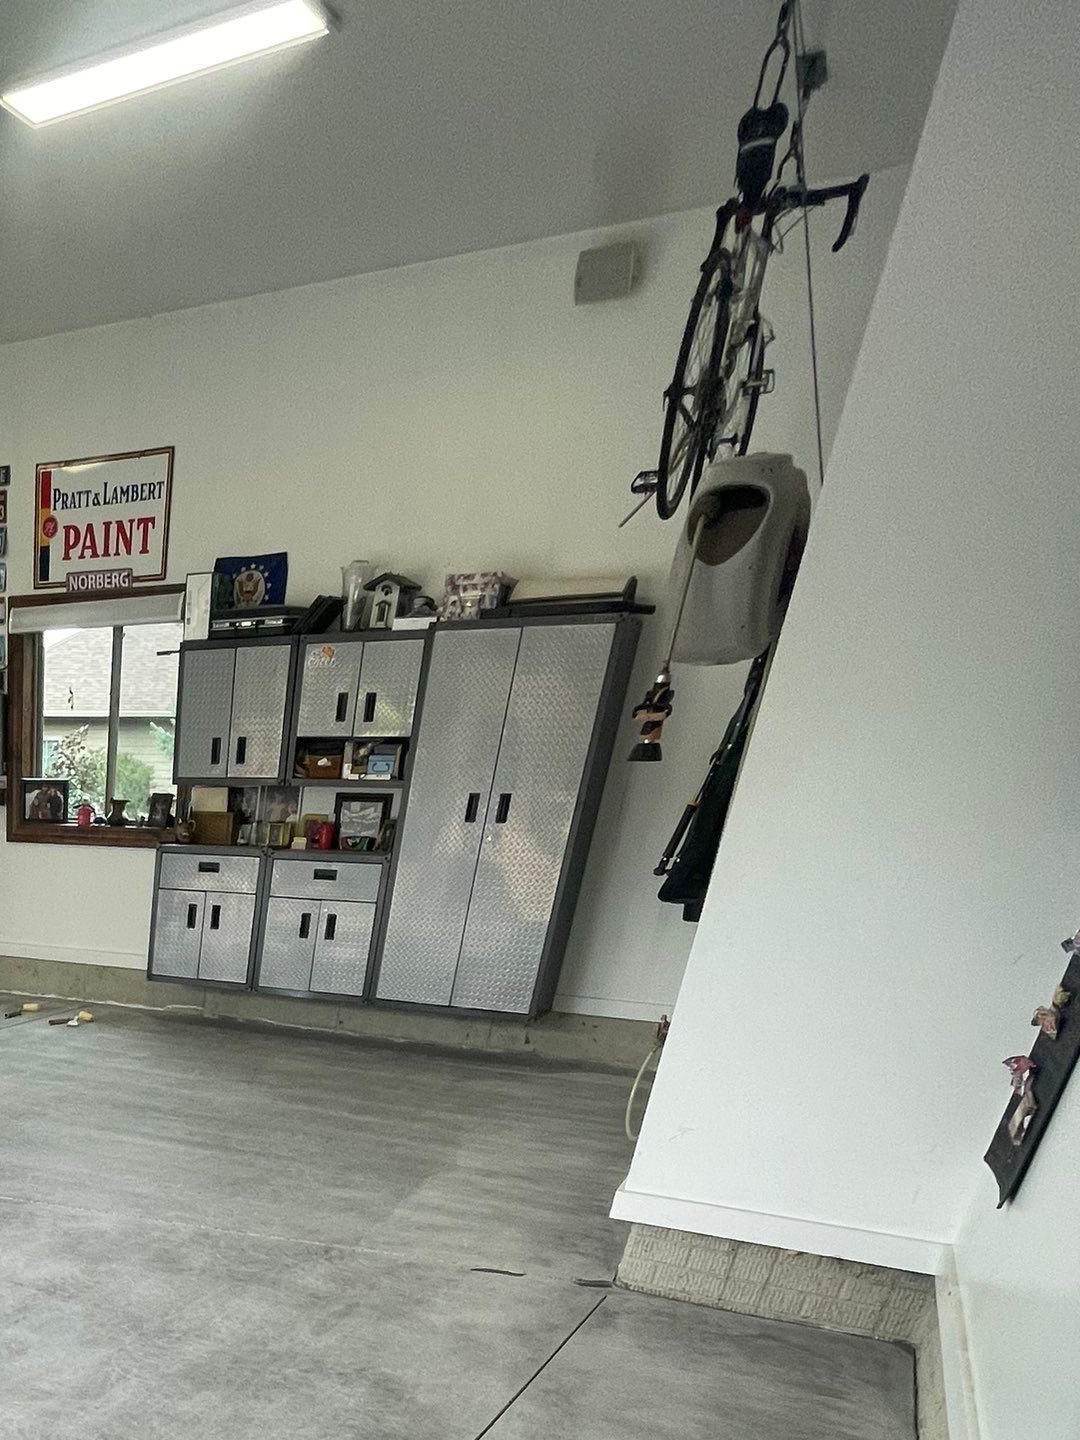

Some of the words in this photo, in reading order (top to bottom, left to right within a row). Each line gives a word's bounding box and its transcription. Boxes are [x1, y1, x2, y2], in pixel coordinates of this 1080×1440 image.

[53, 488, 92, 511] PRATT
[103, 481, 165, 506] LAMBERT
[62, 516, 156, 561] PAINT
[68, 571, 129, 591] NORBERG
